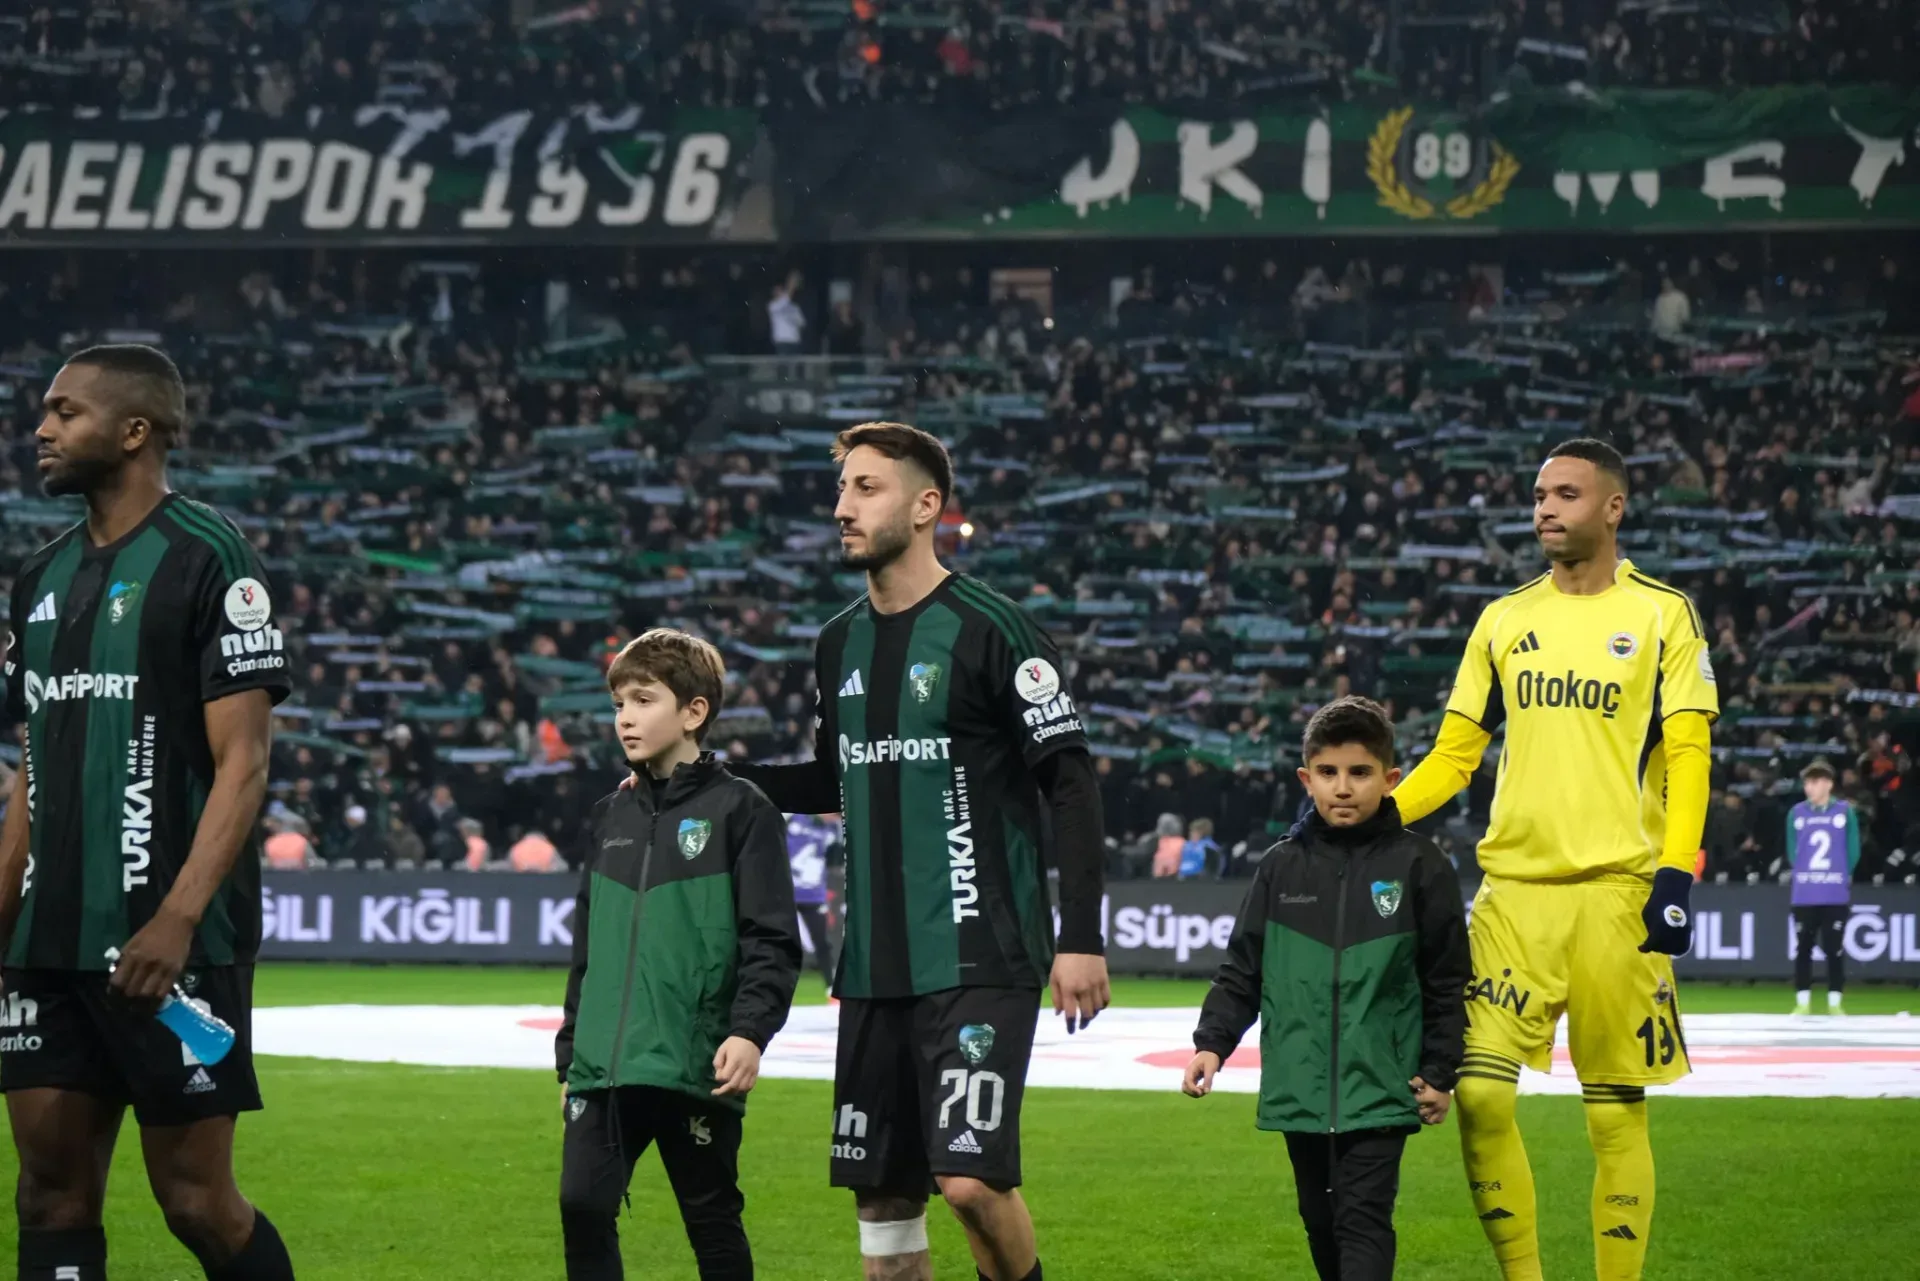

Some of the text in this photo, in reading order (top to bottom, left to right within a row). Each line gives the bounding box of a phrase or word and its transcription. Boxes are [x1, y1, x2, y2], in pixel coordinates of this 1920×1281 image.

[1413, 131, 1472, 179] 89
[0, 138, 433, 230] AELISPOR
[220, 623, 283, 657] nuh
[227, 654, 284, 677] çimnto
[1022, 691, 1077, 727] nuh
[1517, 669, 1622, 719] Otokoç
[126, 739, 140, 774] ARAÇ
[141, 714, 156, 777] MUAYENE
[942, 789, 955, 821] ARAÇ
[954, 765, 970, 820] MUAYENE
[1808, 829, 1831, 870] 2
[939, 1068, 1005, 1132] 70
[948, 1143, 983, 1154] adidas
